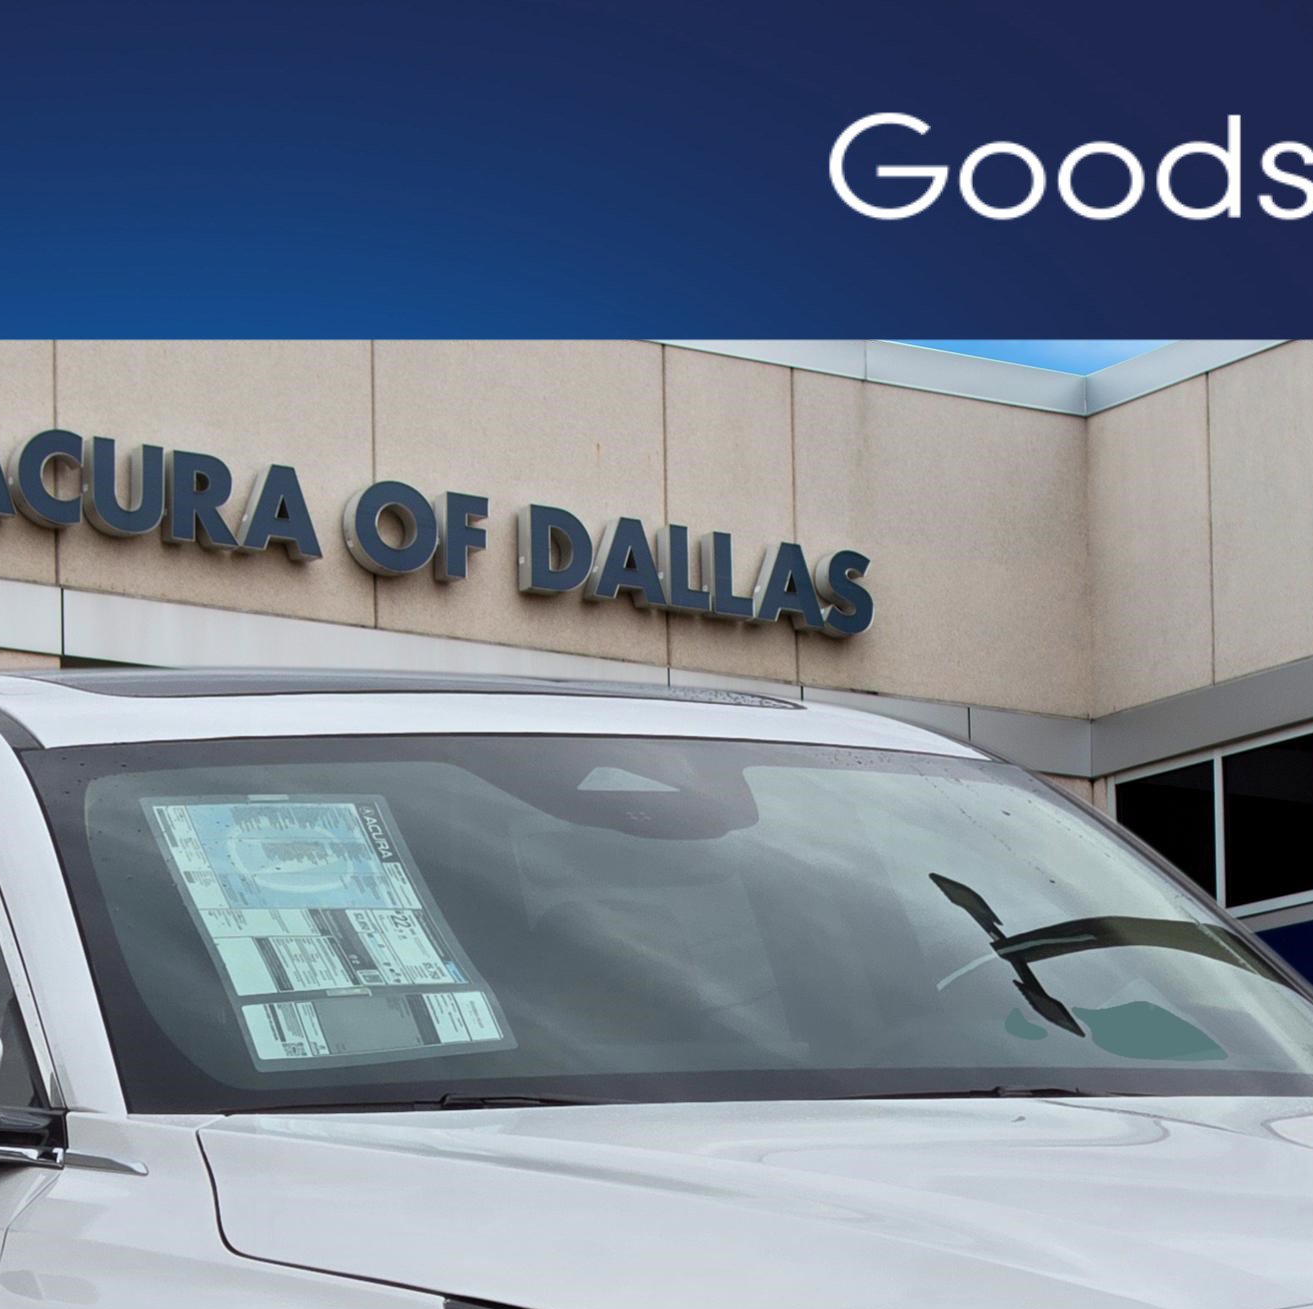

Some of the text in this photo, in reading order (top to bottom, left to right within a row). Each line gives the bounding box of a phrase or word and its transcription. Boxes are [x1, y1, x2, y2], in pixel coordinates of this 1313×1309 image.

[344, 480, 488, 582] OF
[519, 502, 875, 639] DALLAS
[363, 816, 393, 858] ACURA
